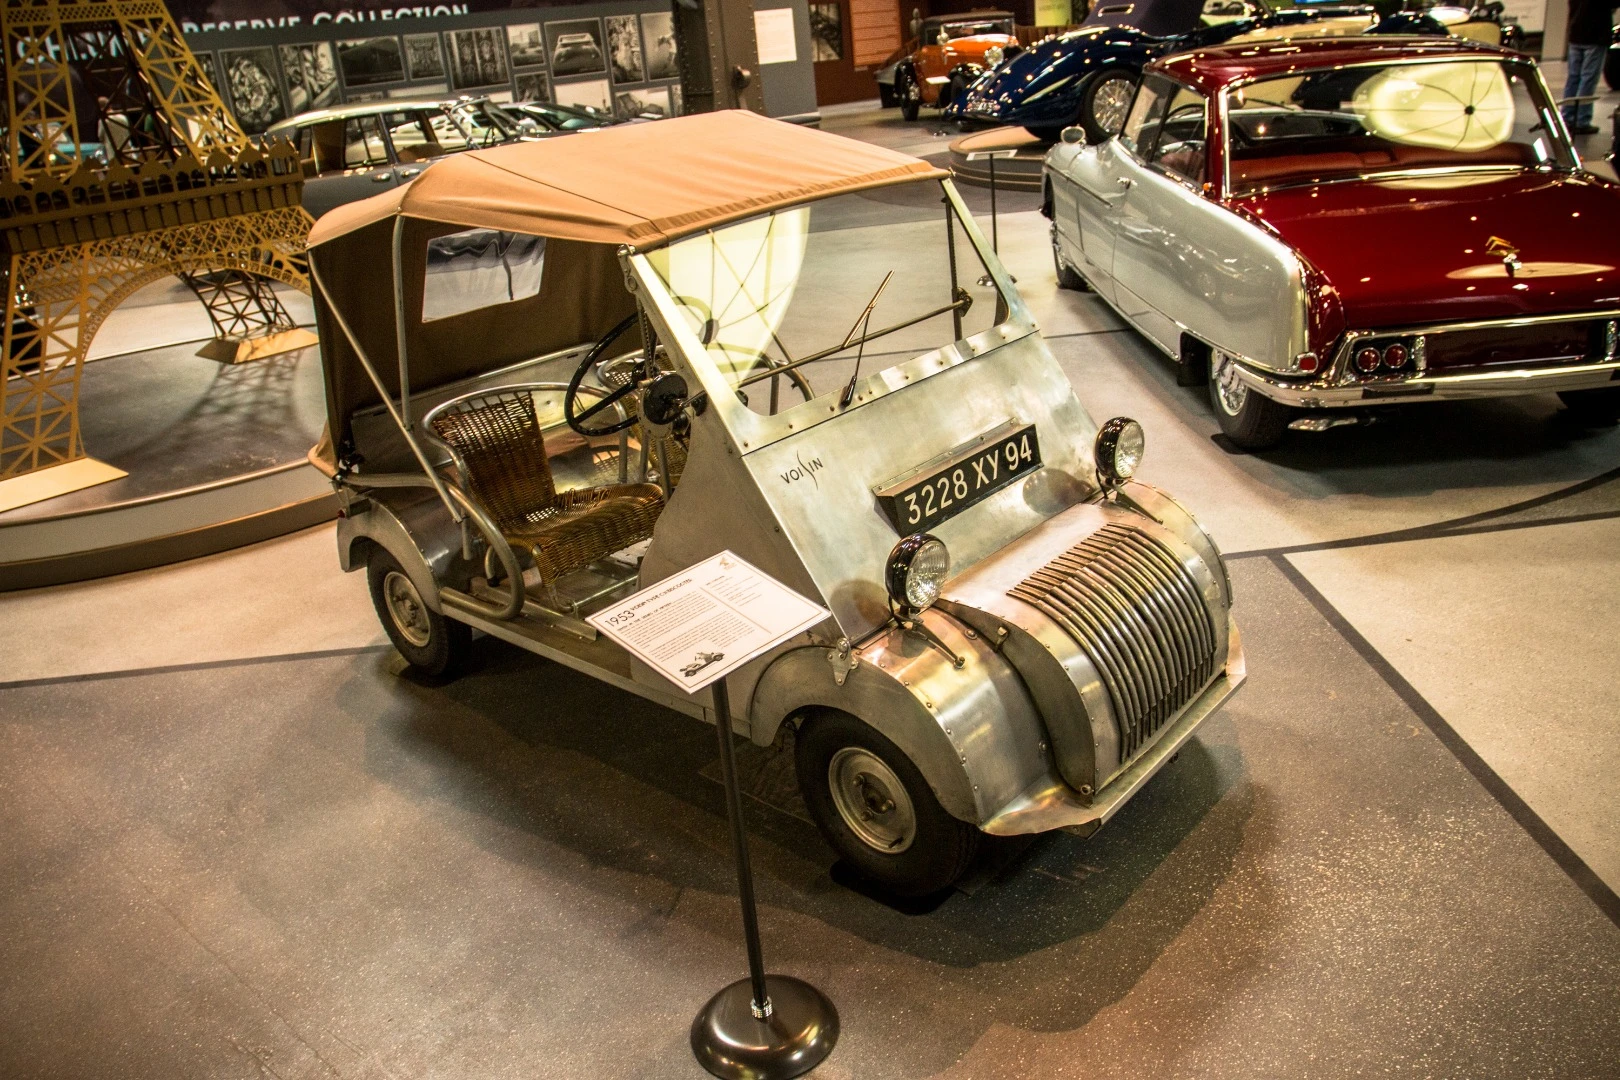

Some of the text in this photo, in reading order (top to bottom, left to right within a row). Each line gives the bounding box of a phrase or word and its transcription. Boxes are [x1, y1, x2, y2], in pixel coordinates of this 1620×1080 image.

[780, 449, 824, 491] VOISIN
[904, 434, 1032, 525] 3228 XY 94
[604, 609, 635, 627] 1953
